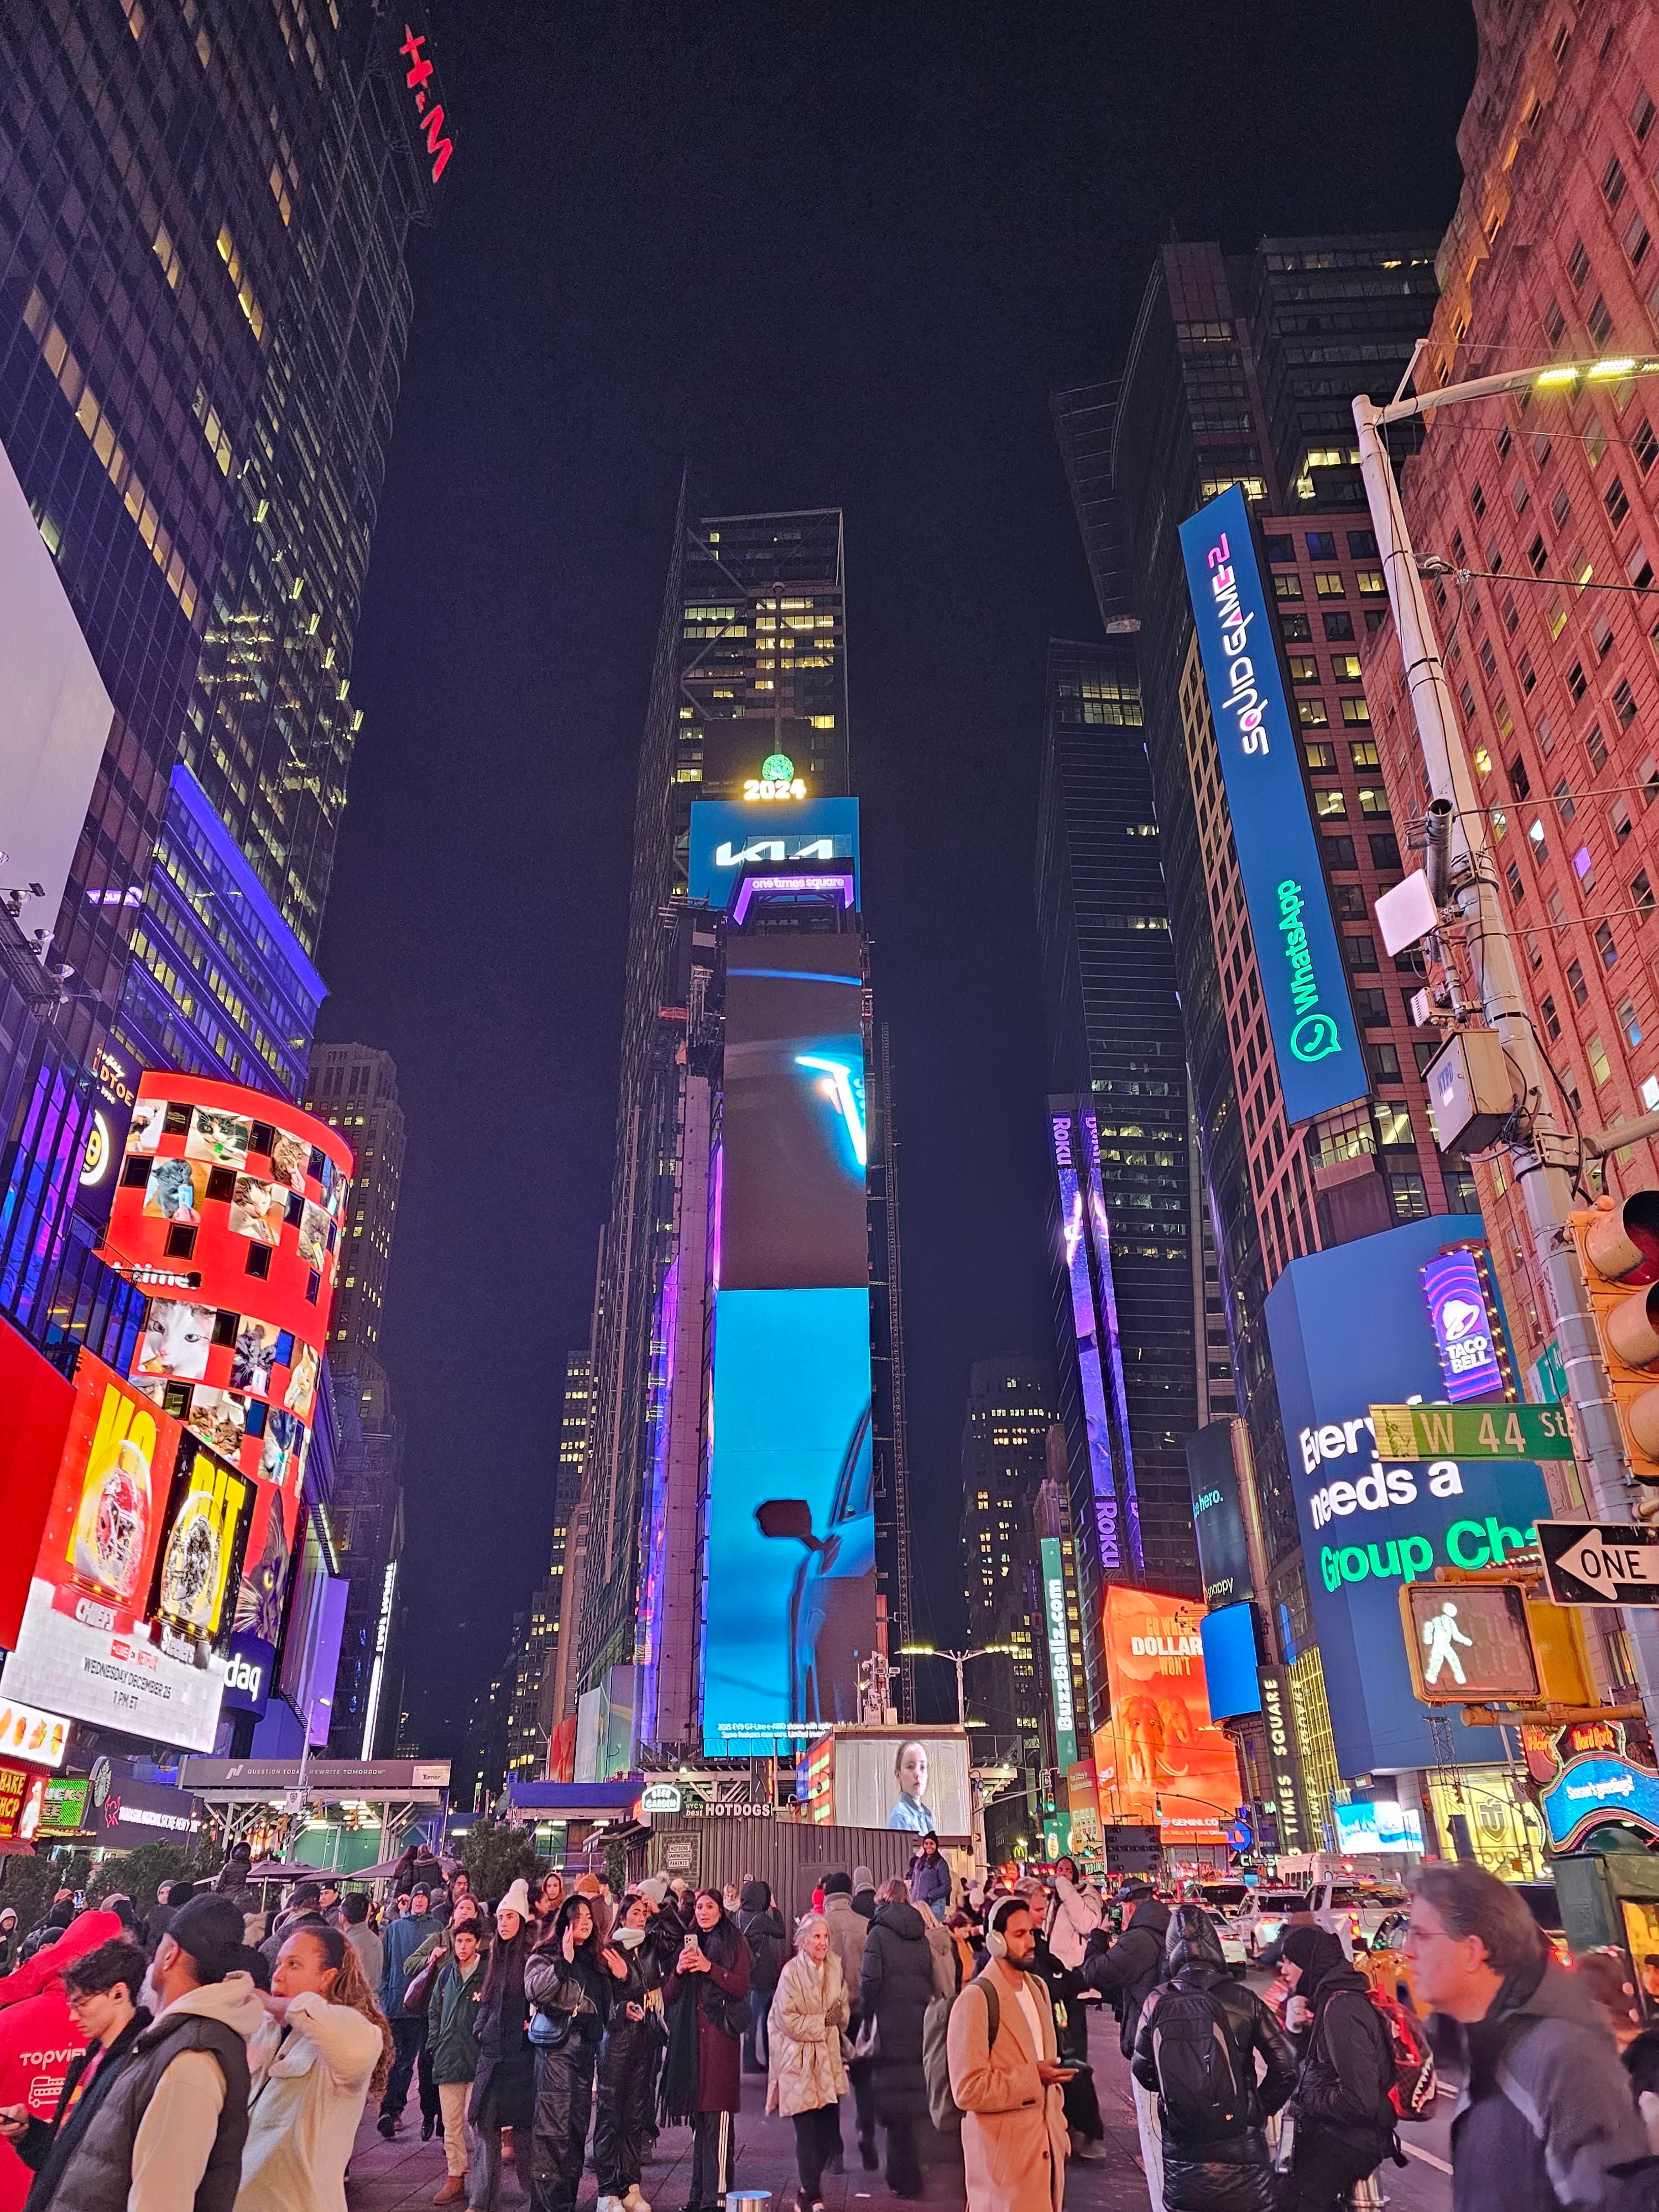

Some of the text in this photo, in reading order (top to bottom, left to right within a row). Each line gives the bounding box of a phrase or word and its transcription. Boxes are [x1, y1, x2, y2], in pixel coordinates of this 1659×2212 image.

[1208, 532, 1270, 755] SQUID GAME 2
[744, 779, 806, 800] 2024
[752, 877, 844, 890] one times square
[1277, 879, 1318, 1015] WhatsApp
[1437, 1061, 1453, 1097] NYPD
[1444, 1335, 1488, 1361] TACO
[1451, 1350, 1491, 1375] BELL
[1420, 1411, 1568, 1454] W 44 St
[1198, 1490, 1223, 1512] hero.
[1310, 1459, 1464, 1530] needs a
[1321, 1534, 1434, 1594] Group
[1579, 1549, 1648, 1580] ONE
[1207, 1577, 1234, 1601] snappy
[76, 1597, 117, 1632] CHIEFS
[1145, 1616, 1160, 1636] GO
[1048, 1578, 1073, 1731] BuzzBallz.com
[1158, 1656, 1191, 1677] WON'T
[84, 1657, 172, 1699] WEDNESDAY DECEMBER 25
[117, 1692, 129, 1708] PM
[128, 1694, 139, 1710] ET
[1264, 1678, 1287, 1756] SQUARE
[1574, 1726, 1616, 1751] Hard Rock
[685, 1803, 770, 1817] best HOTDOGS
[1278, 1775, 1300, 1836] TIMES
